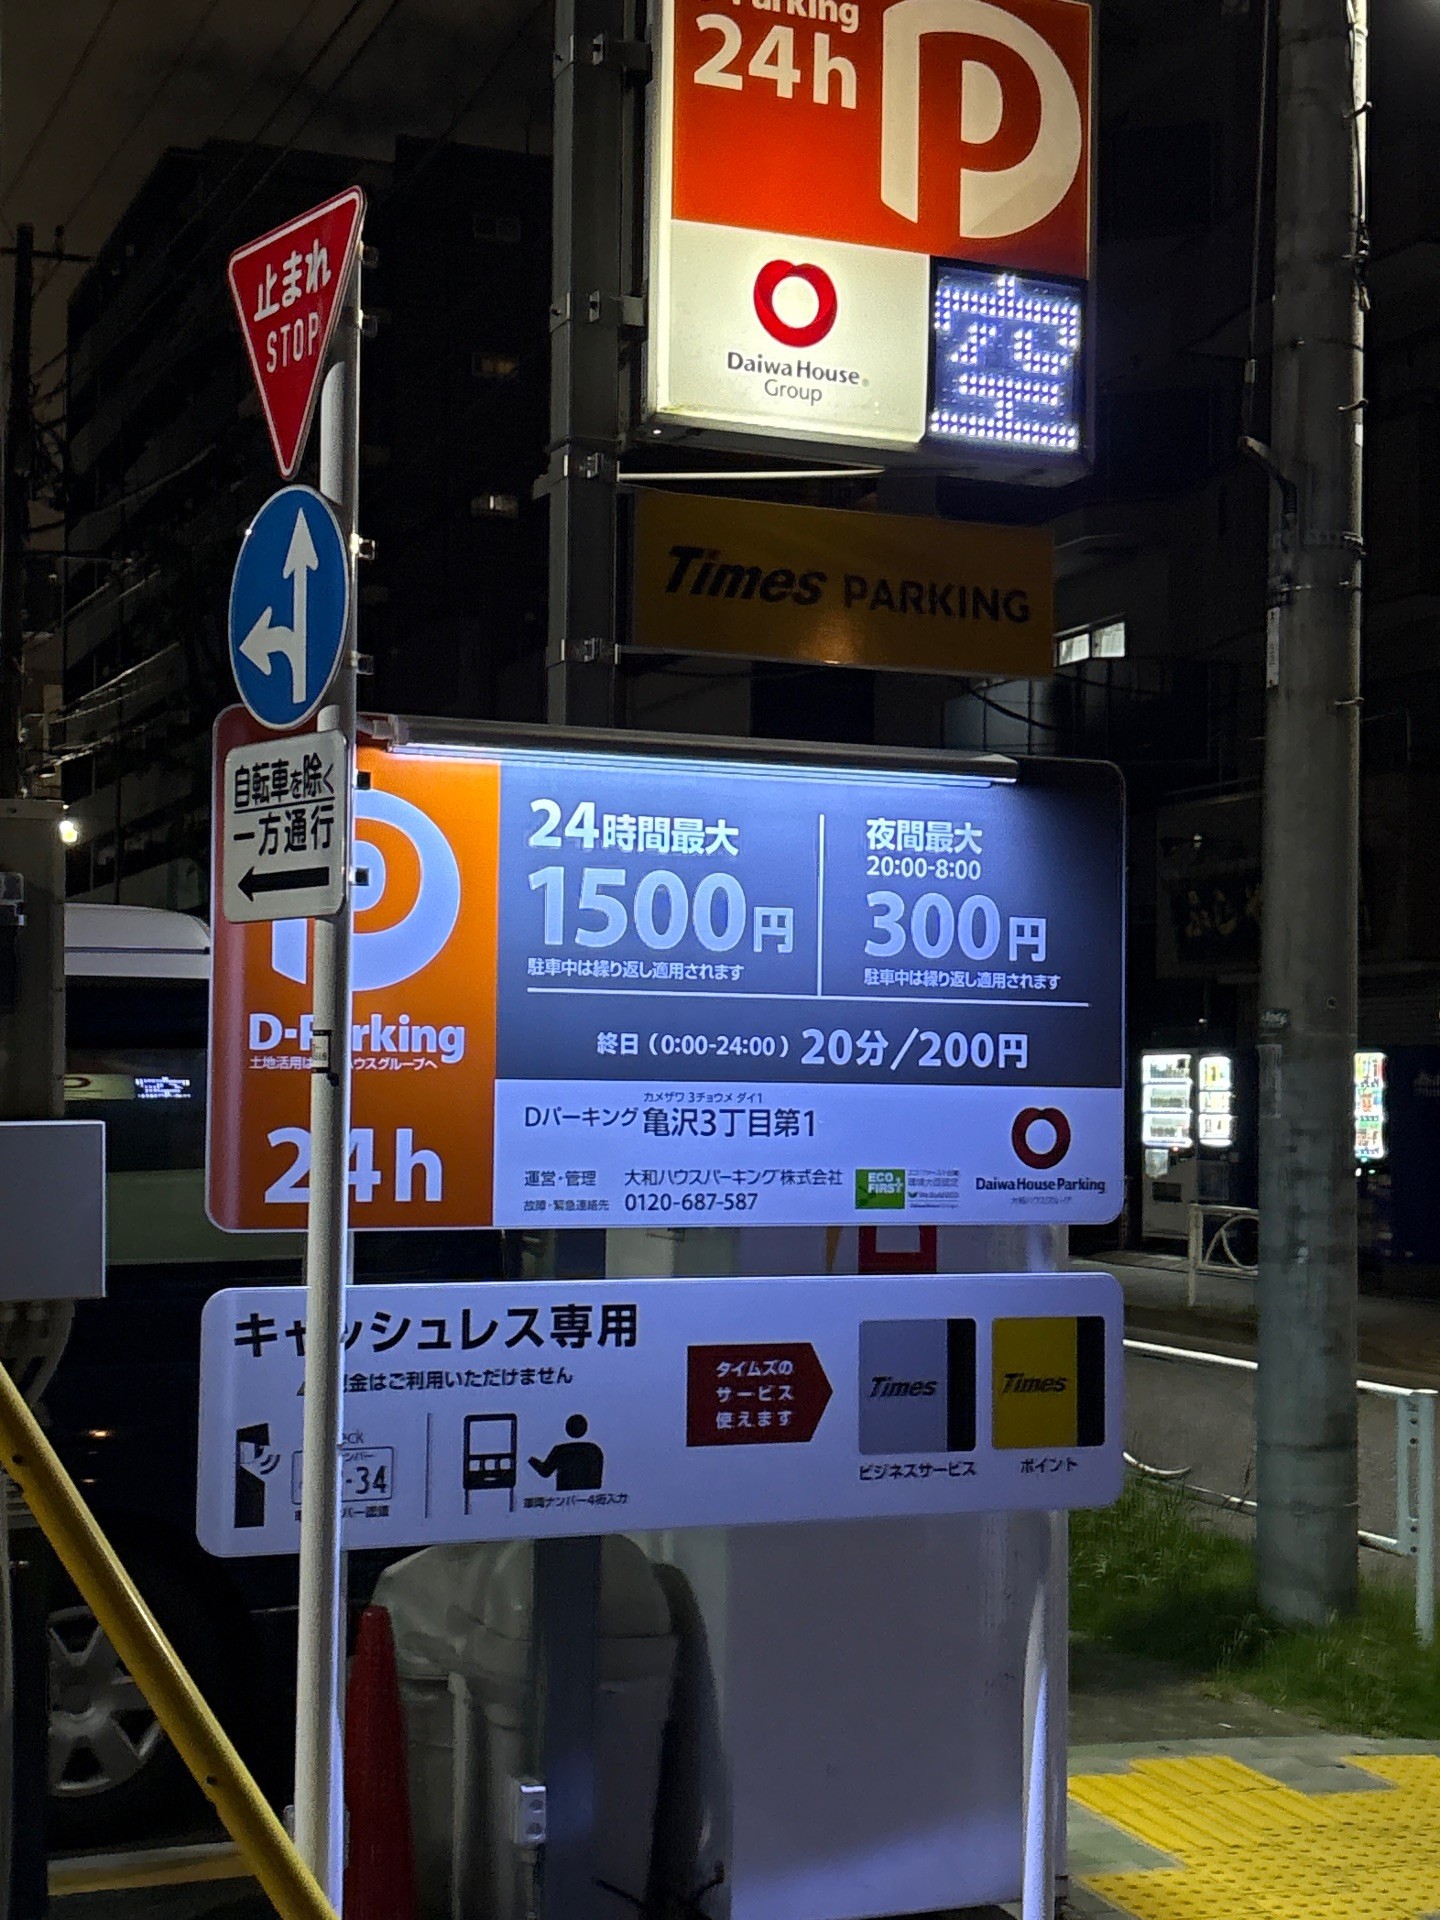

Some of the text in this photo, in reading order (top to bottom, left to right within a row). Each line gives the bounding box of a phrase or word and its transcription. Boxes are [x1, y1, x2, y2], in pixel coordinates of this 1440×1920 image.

[694, 13, 857, 109] 24h
[253, 238, 332, 323] 止まれ
[266, 311, 320, 374] STOP
[727, 352, 860, 386] Daiwa House
[929, 272, 1082, 450] 空
[764, 379, 823, 404] Group
[665, 545, 1031, 624] Times PARKING
[234, 752, 335, 807] 自転車を除く
[233, 805, 335, 857] 一方通行
[528, 798, 739, 856] 24時間最大
[866, 817, 983, 855] 夜間最大
[866, 855, 982, 880] 20:00-8:00
[528, 866, 794, 953] 1500円
[864, 890, 1047, 962] 300円
[527, 957, 744, 981] 駐車中は繰り返し適用されます
[864, 967, 1061, 990] 駐車中は繰り返し適用されます
[524, 1170, 597, 1187] 運営・管理
[625, 1168, 843, 1187] 大和ハウスパーキング株式会社
[867, 1172, 894, 1183] ECO
[867, 1183, 902, 1194] FIRST
[975, 1176, 1106, 1194] Daiwa House Parking
[625, 1193, 758, 1212] 0120-687-587
[343, 1367, 574, 1394] 金はご利用いただけません
[716, 1360, 794, 1378] タイムズの
[716, 1385, 794, 1403] サービス
[870, 1376, 938, 1399] Times
[1001, 1372, 1069, 1394] Times
[716, 1410, 793, 1430] 使えます
[859, 1461, 977, 1482] ビジネスサービス
[1020, 1457, 1079, 1475] ポイント
